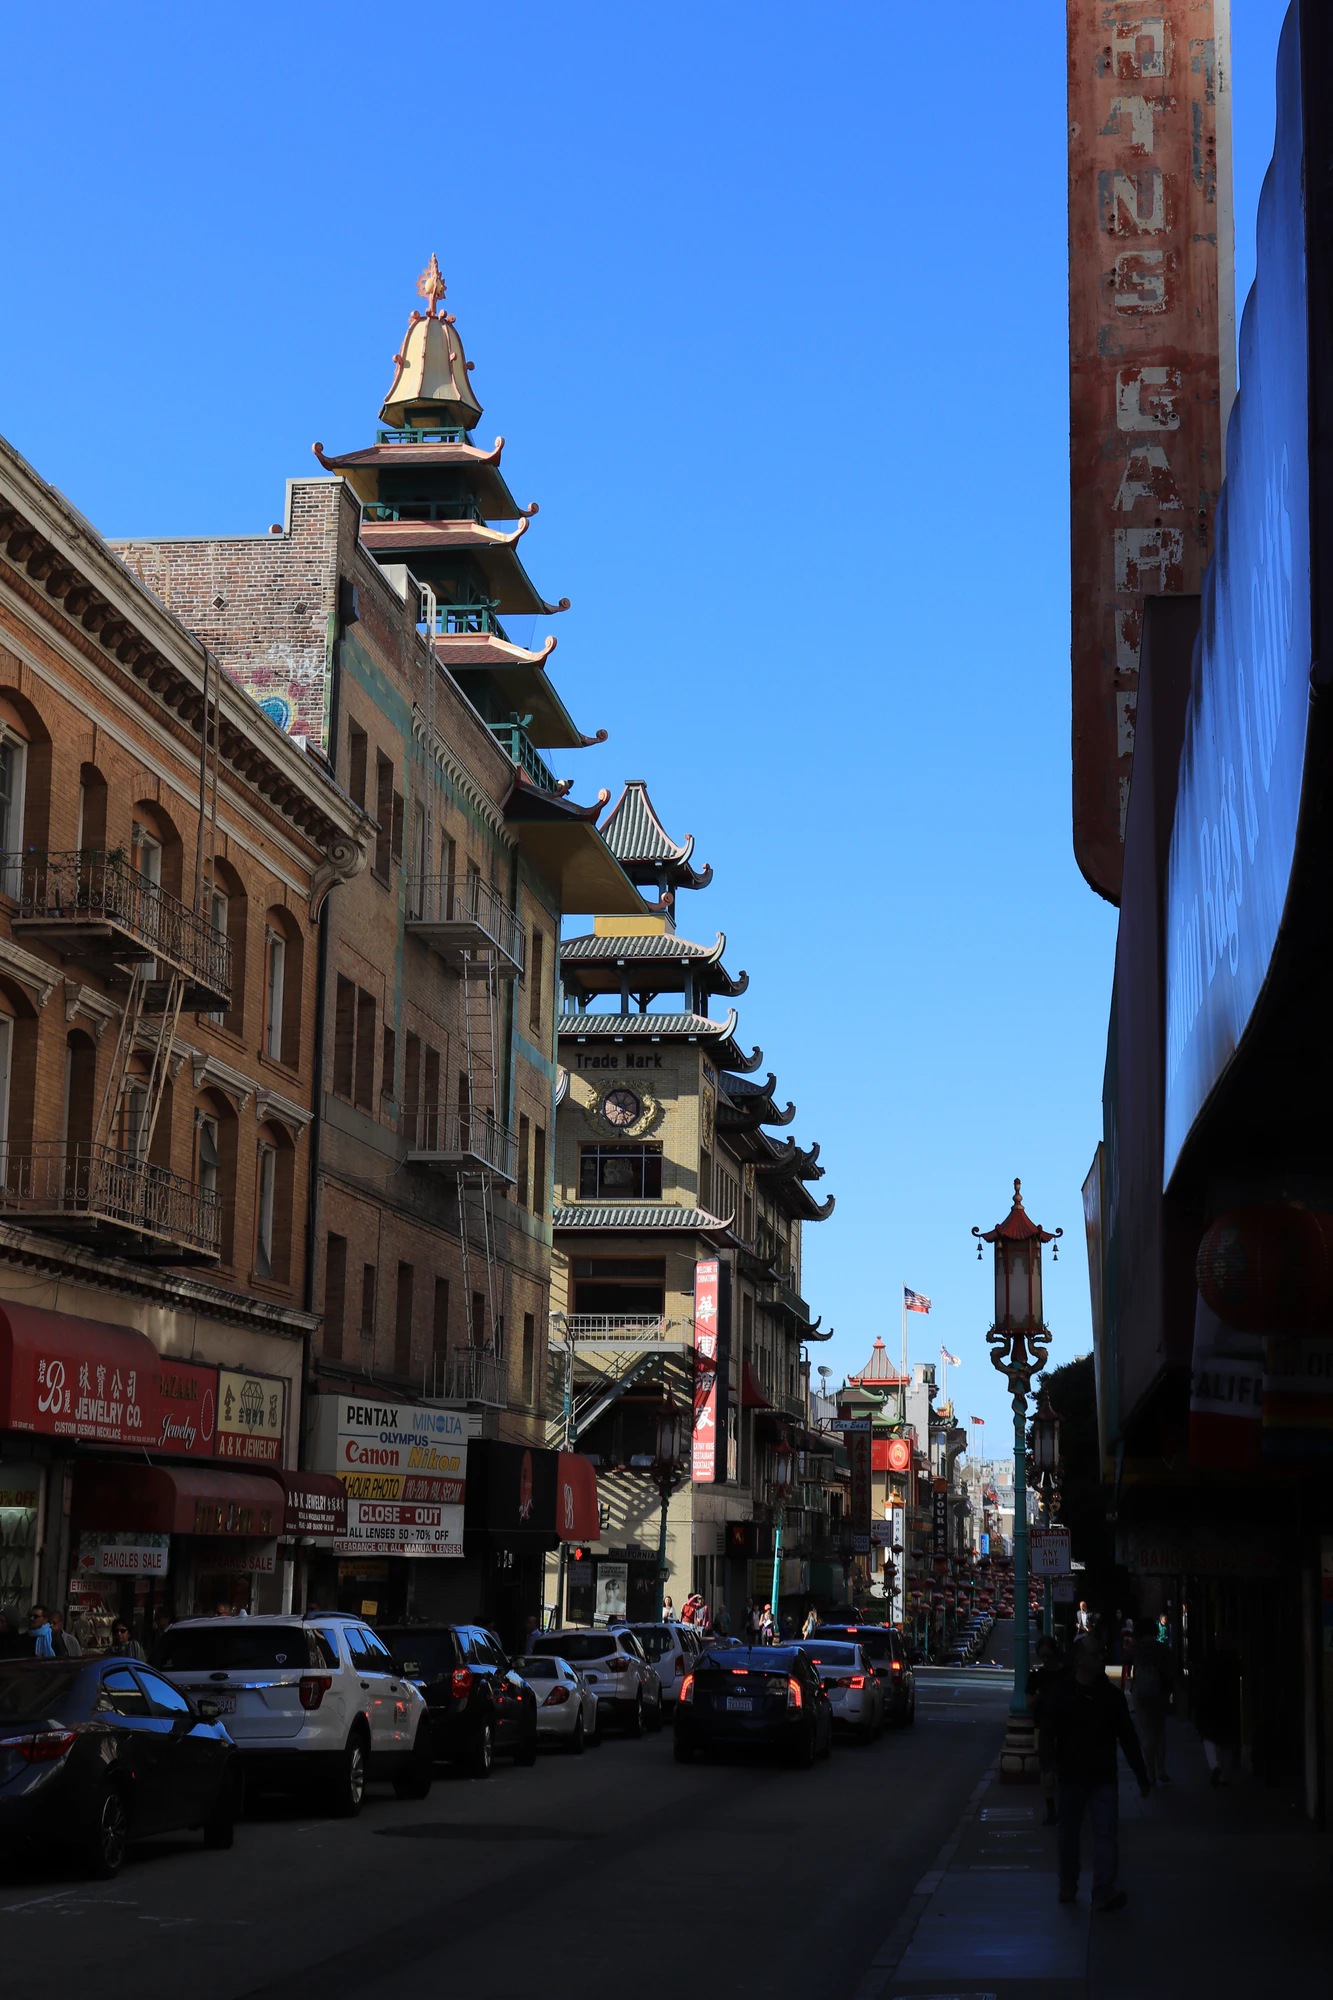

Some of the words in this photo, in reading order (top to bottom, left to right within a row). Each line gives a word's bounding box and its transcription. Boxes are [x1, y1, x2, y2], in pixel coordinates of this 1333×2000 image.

[1200, 754, 1243, 987] Bags
[1236, 658, 1259, 866] &
[1250, 441, 1293, 794] Gifts
[575, 1053, 618, 1068] Trade
[626, 1052, 662, 1068] Mark
[75, 1397, 124, 1424] JEWELRY
[126, 1404, 142, 1427] CO.
[347, 1405, 398, 1427] PENTAX
[54, 1421, 76, 1434] CUSTOM
[77, 1424, 96, 1436] DESIGN
[97, 1427, 121, 1440] NECKLACE
[158, 1413, 197, 1449] Jewelry
[412, 1412, 462, 1435] MINOLTA
[834, 1421, 847, 1429] Far
[852, 1421, 868, 1429] East
[219, 1435, 225, 1455] A
[227, 1436, 233, 1455] &
[235, 1437, 242, 1456] K
[243, 1439, 278, 1459] JEWELRY
[380, 1432, 428, 1447] OLYMPUS
[345, 1440, 399, 1466] Canon
[408, 1447, 460, 1471] Nikon
[348, 1477, 371, 1497] HOUR
[371, 1478, 399, 1498] PHOTO
[15, 1491, 36, 1506] OFF
[288, 1491, 293, 1507] A
[294, 1491, 299, 1508] &
[300, 1492, 304, 1508] K
[305, 1493, 326, 1510] JEWELRY
[360, 1505, 400, 1522] CLOSE
[415, 1508, 440, 1524] OUT
[936, 1493, 944, 1524] FOUR
[349, 1527, 363, 1538] ALL
[365, 1528, 395, 1539] LENSES
[416, 1530, 430, 1540] 70%
[435, 1530, 449, 1540] OFF
[937, 1530, 945, 1553] SEA
[1032, 1537, 1041, 1547] NO
[1043, 1539, 1068, 1548] STOPPING
[335, 1542, 376, 1552] CLEARANCE
[378, 1543, 388, 1552] ON
[390, 1543, 402, 1552] ALL
[404, 1543, 434, 1553] MANUAL
[435, 1544, 461, 1553] LENSES
[610, 1550, 656, 1559] CALIFORNIA
[103, 1552, 139, 1568] BANGLES
[142, 1553, 161, 1568] SALE
[212, 1555, 246, 1569] PEARLS
[250, 1557, 273, 1571] SALE
[71, 1580, 112, 1591] ETIREMENT
